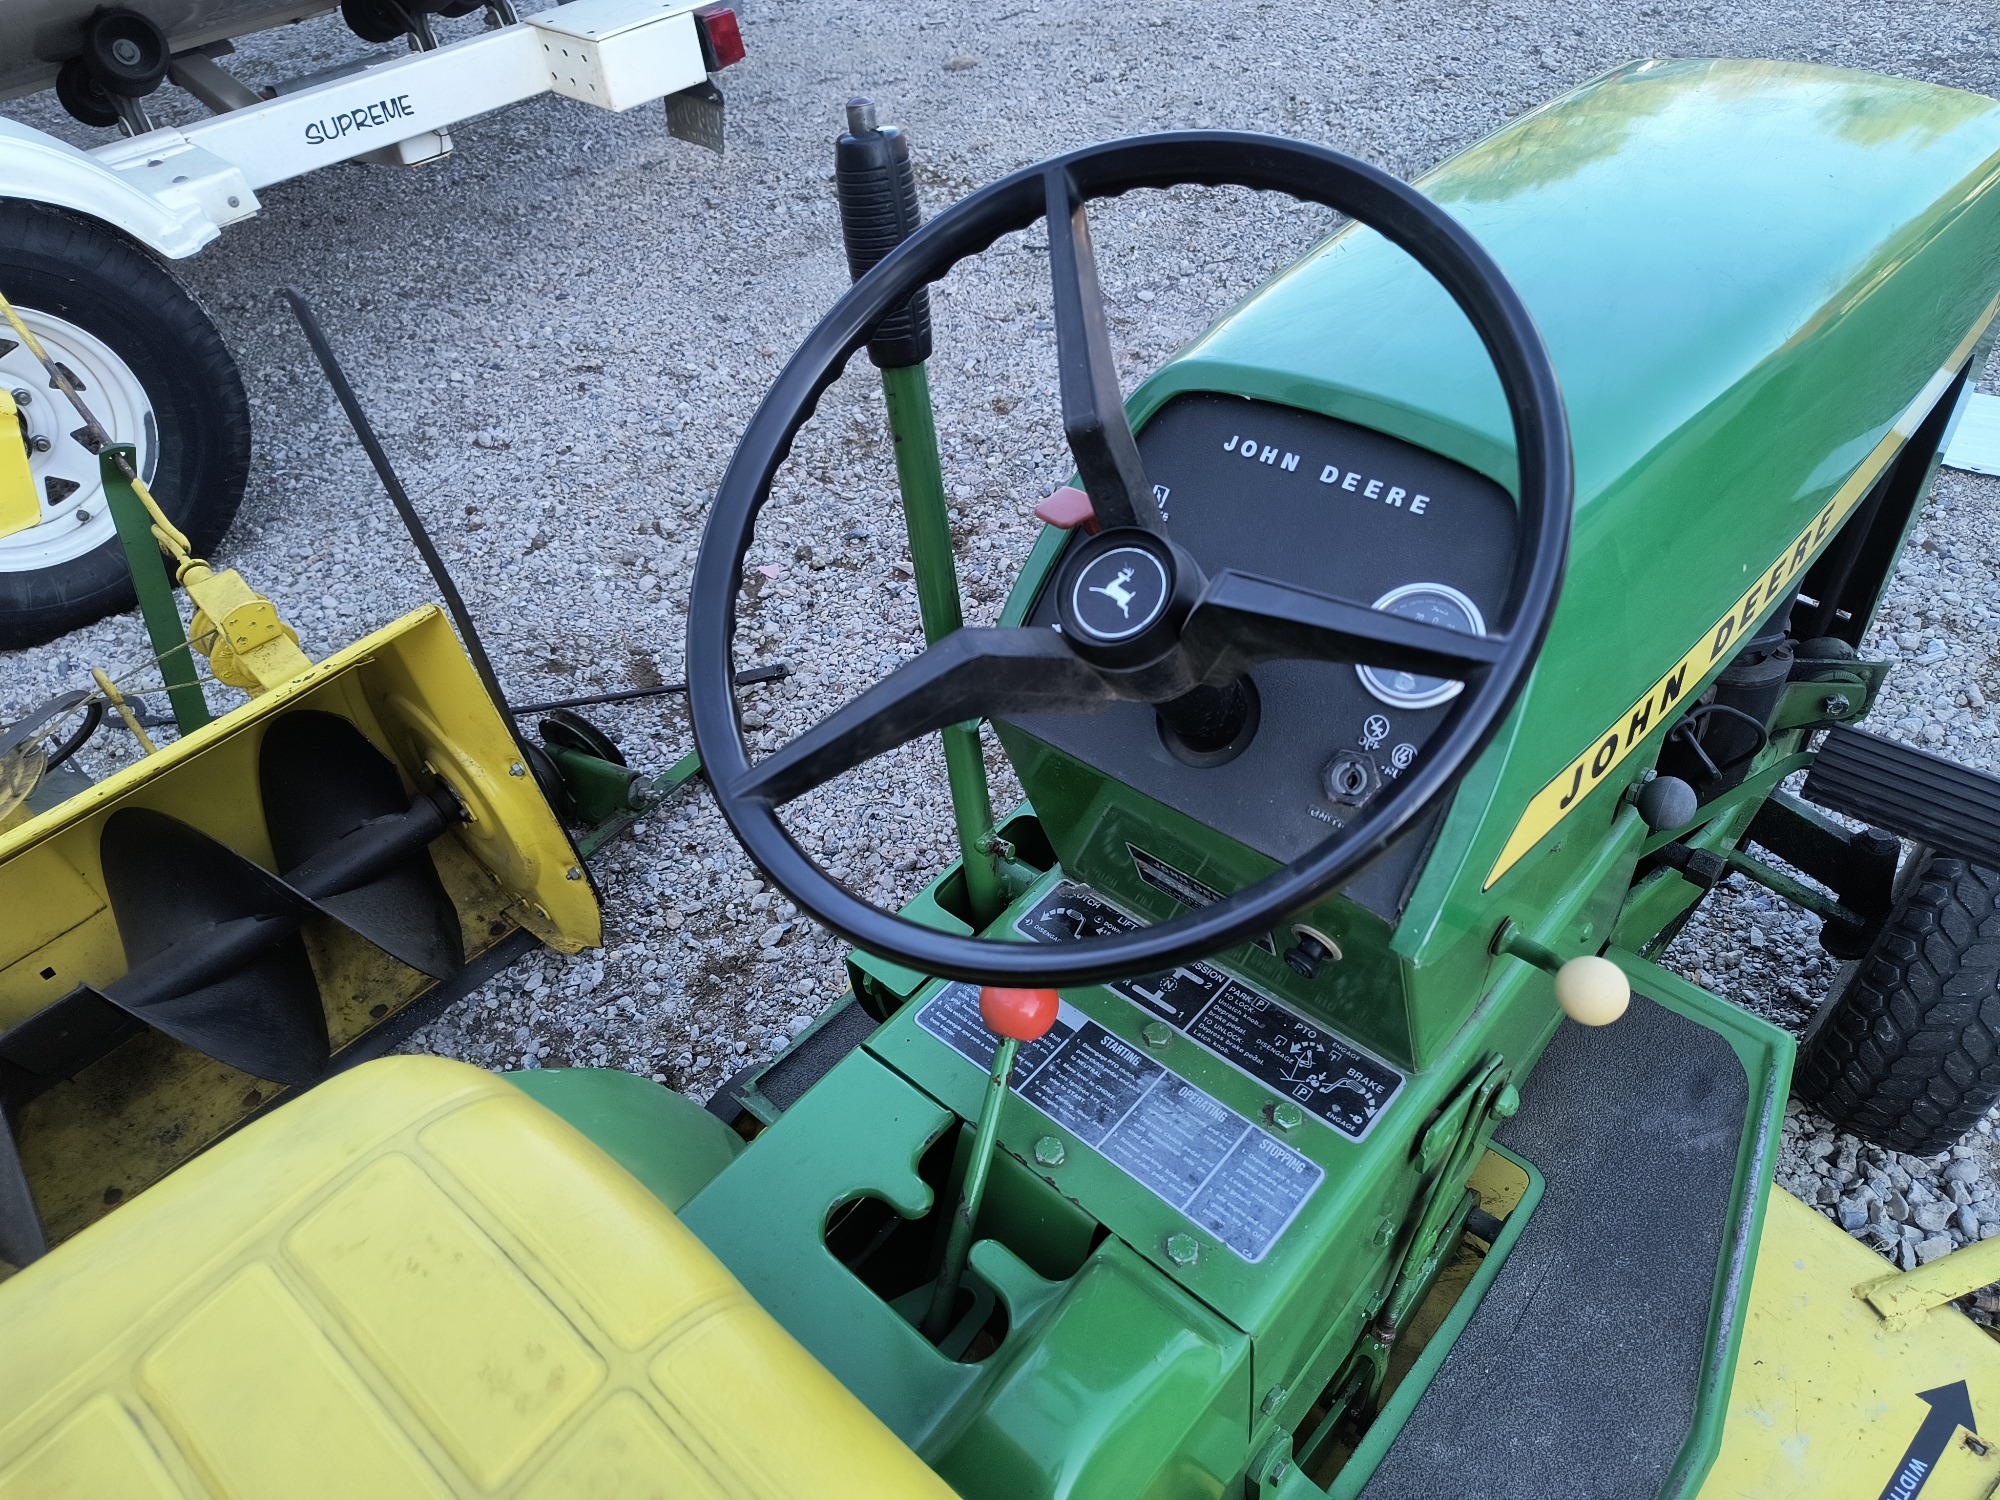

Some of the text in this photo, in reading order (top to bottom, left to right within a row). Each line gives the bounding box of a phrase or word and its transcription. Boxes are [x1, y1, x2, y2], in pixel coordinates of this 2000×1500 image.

[305, 94, 414, 144] SUPREME
[1223, 435, 1430, 515] JOHN DEERE
[1559, 501, 1837, 810] JOHN DEERE
[1072, 890, 1101, 909] UTCH
[1116, 916, 1138, 931] LIFT
[1162, 979, 1174, 989] N
[1203, 981, 1213, 990] 2
[1227, 986, 1253, 1003] PARK
[1211, 1004, 1239, 1023] Depress
[1217, 998, 1242, 1015] Unlatch
[1222, 992, 1256, 1014] TO LOCK:
[1255, 999, 1265, 1008] P
[1201, 1016, 1245, 1044] TO UNLOCK:
[1207, 1009, 1247, 1037] brake pedal.
[1293, 1022, 1318, 1039] PTO
[1036, 1035, 1055, 1050] arking
[1099, 1035, 1142, 1066] STARTING
[1192, 1029, 1231, 1055] Latch knob.
[1197, 1022, 1265, 1067] Depress brake pedal.
[1255, 1038, 1295, 1064] DISENGAGE
[1331, 1041, 1361, 1061] ENGAGE
[1081, 1042, 1108, 1062] Disengage
[1106, 1058, 1119, 1068] PTO
[1062, 1062, 1076, 1073] Move
[1075, 1071, 1089, 1082] lever
[1074, 1049, 1089, 1060] press
[1088, 1057, 1104, 1069] clutch
[1118, 1076, 1129, 1085] and
[1048, 1076, 1060, 1086] wise
[1066, 1088, 1087, 1104] START.
[1055, 1069, 1069, 1081] Turn
[1067, 1079, 1090, 1097] ignition
[1089, 1093, 1101, 1104] key
[1297, 1087, 1308, 1097] P
[1345, 1067, 1385, 1094] BRAKE
[1040, 1095, 1059, 1109] engine
[1177, 1085, 1229, 1122] OPERATING
[1075, 1108, 1091, 1121] lower
[1091, 1119, 1105, 1130] lever
[1207, 1125, 1220, 1135] and
[1325, 1110, 1356, 1132] ENGAGE
[1133, 1121, 1146, 1132] shift
[1147, 1131, 1181, 1156] transmission
[1182, 1155, 1195, 1166] into
[1138, 1115, 1163, 1133] Depress
[1163, 1131, 1183, 1146] clutch
[1182, 1144, 1200, 1159] pedal
[1201, 1157, 1214, 1168] and
[1216, 1142, 1227, 1151] the
[1113, 1143, 1133, 1159] release
[1150, 1170, 1168, 1184] pedal
[1119, 1136, 1141, 1153] Release
[1141, 1152, 1163, 1169] parking
[1164, 1168, 1181, 1181] brake
[1182, 1180, 1194, 1191] and
[1258, 1138, 1307, 1173] STOPPING
[1235, 1167, 1259, 1185] parking
[1241, 1160, 1299, 1200] brake pedals and set
[1291, 1182, 1305, 1192] and
[1228, 1176, 1249, 1192] Lower
[1250, 1191, 1286, 1217] attachment
[1225, 1200, 1247, 1218] engine
[1246, 1214, 1258, 1225] and
[1251, 1230, 1265, 1242] OFF
[1240, 1247, 1254, 1259] CA
